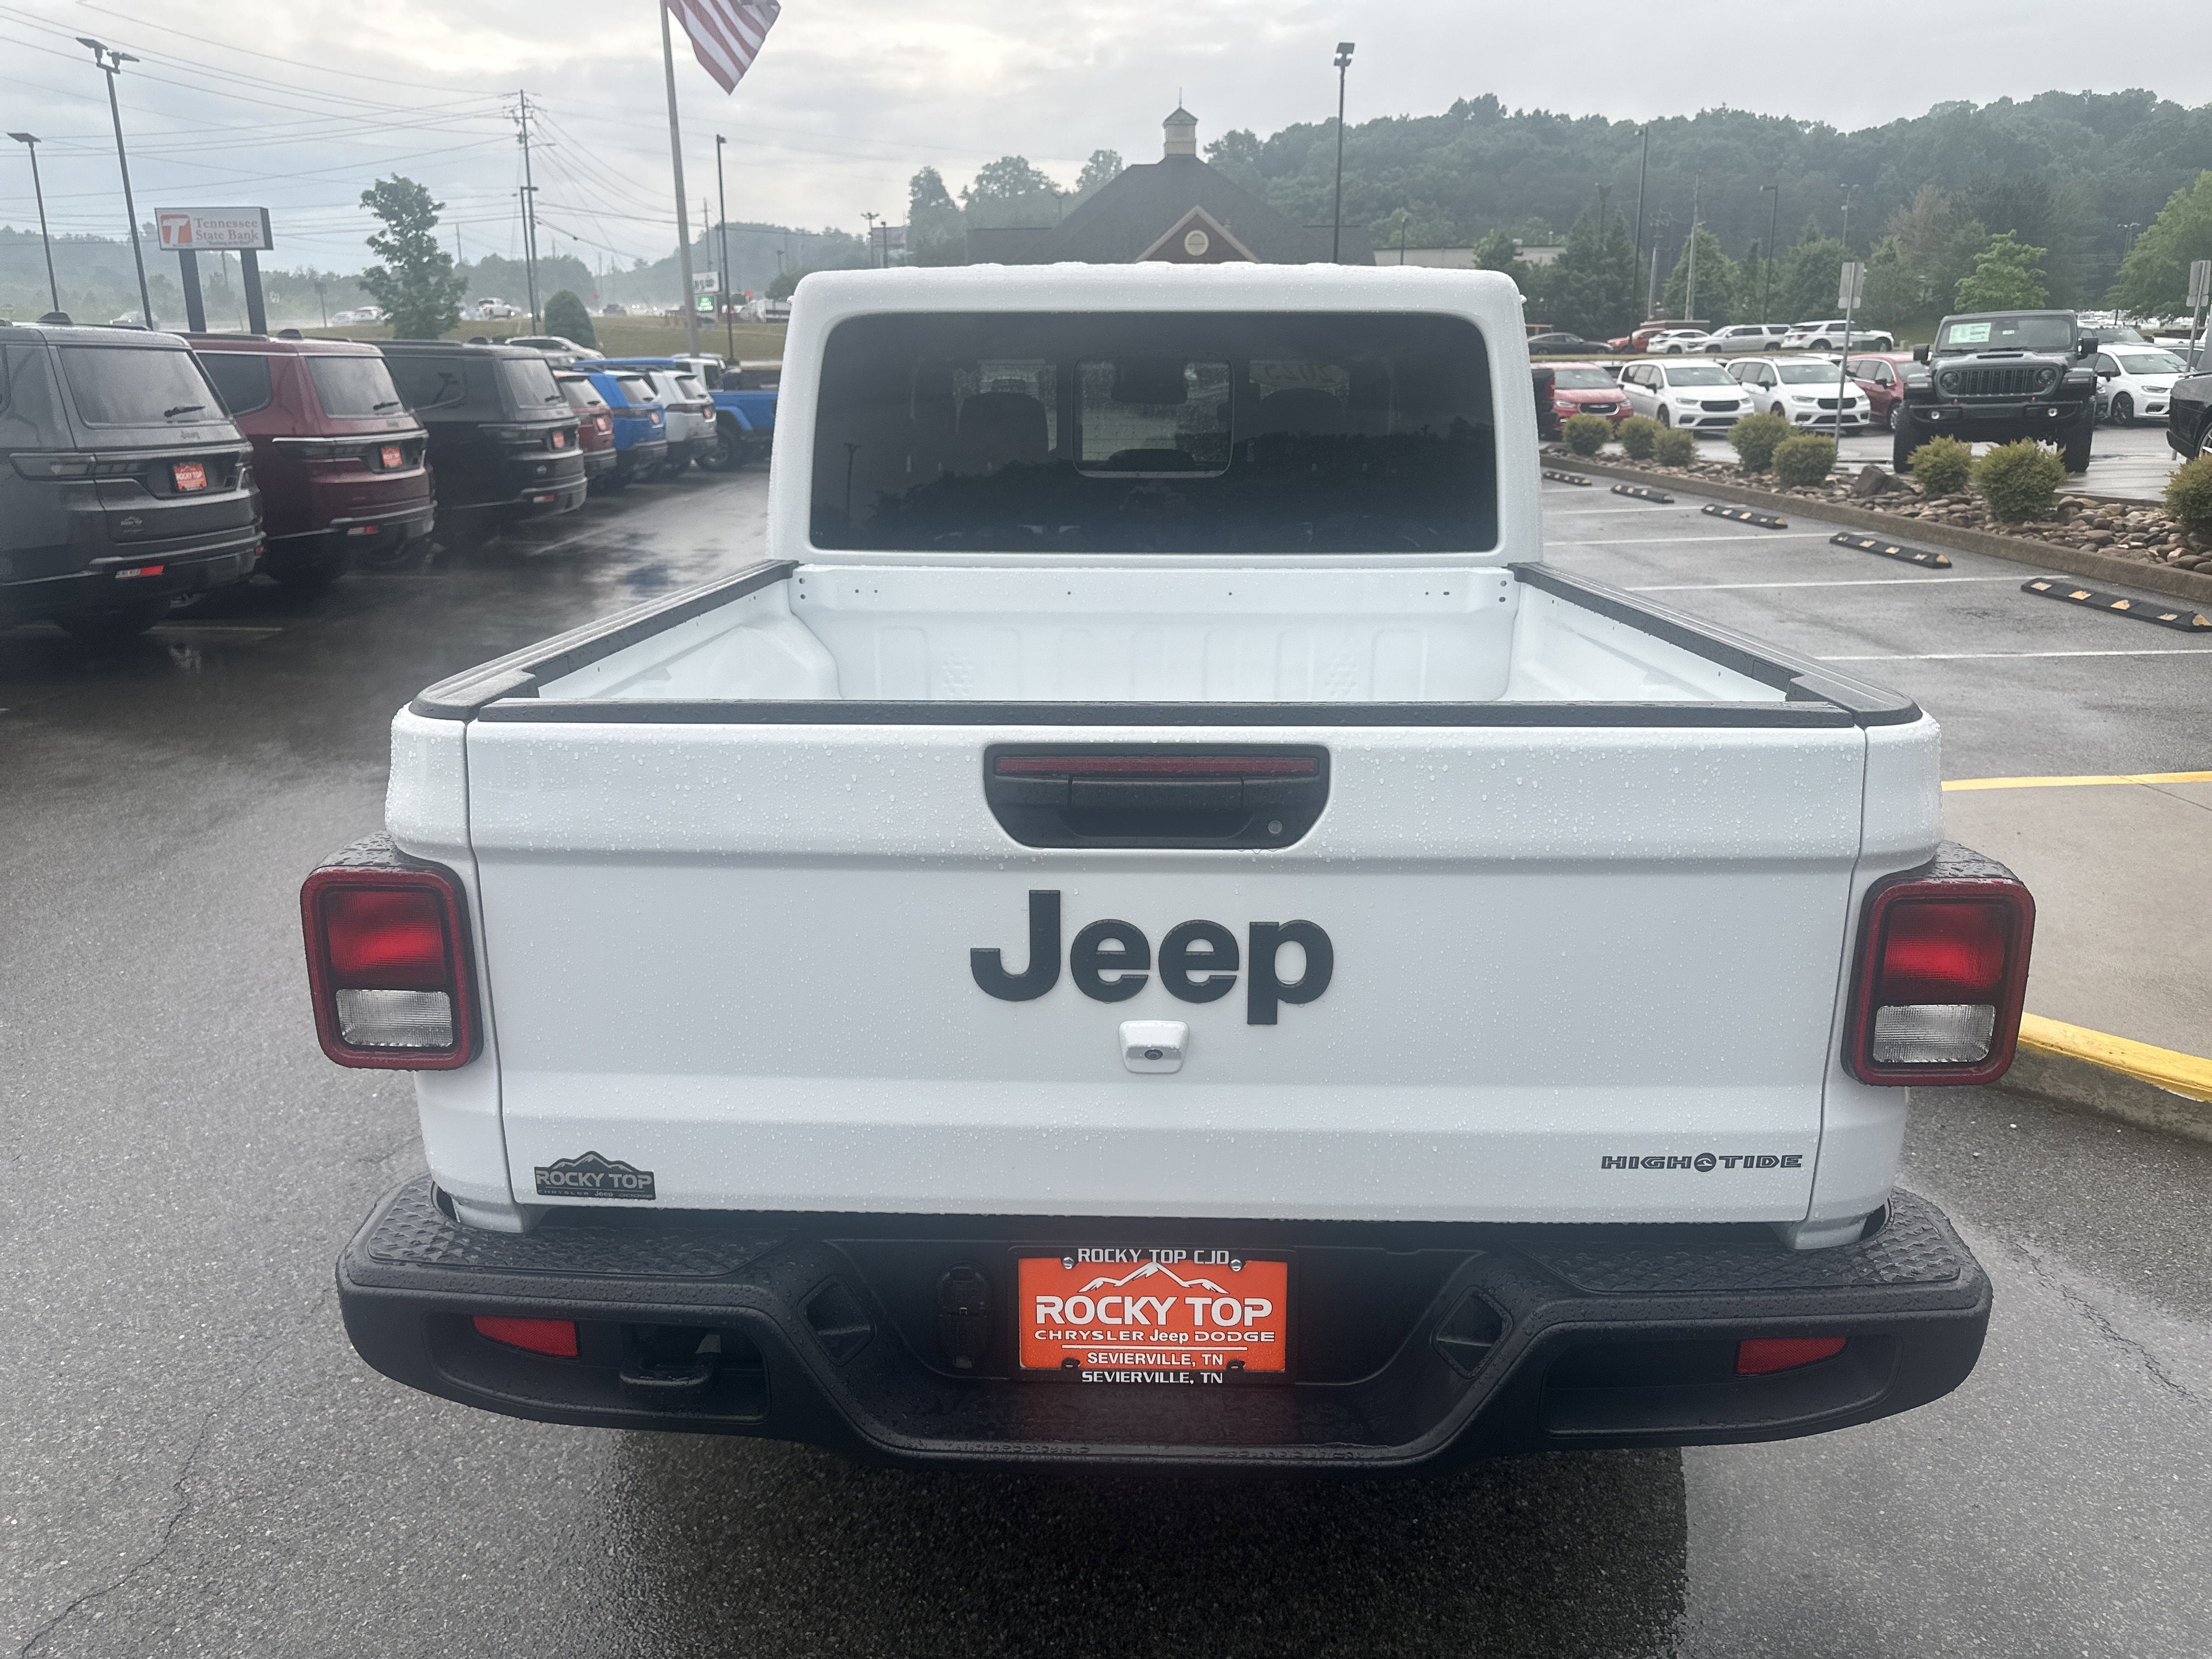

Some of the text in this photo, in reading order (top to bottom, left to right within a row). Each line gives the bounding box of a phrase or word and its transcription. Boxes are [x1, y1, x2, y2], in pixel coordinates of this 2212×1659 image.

[194, 218, 258, 228] Tennessee
[196, 229, 258, 242] State Bank
[970, 889, 1334, 1025] Jeep
[1601, 1154, 1803, 1169] HIGH TIDE
[535, 1170, 653, 1189] ROCKY TOP
[1077, 1248, 1230, 1265] ROCKY TOP CJD
[1035, 1295, 1273, 1327] ROCKY TOP
[1035, 1329, 1275, 1344] CHRYSLER Jeep DODGE
[1087, 1352, 1223, 1367] SEVIERVILLE, TN
[1082, 1372, 1223, 1385] SEVIERVILLE, TN
